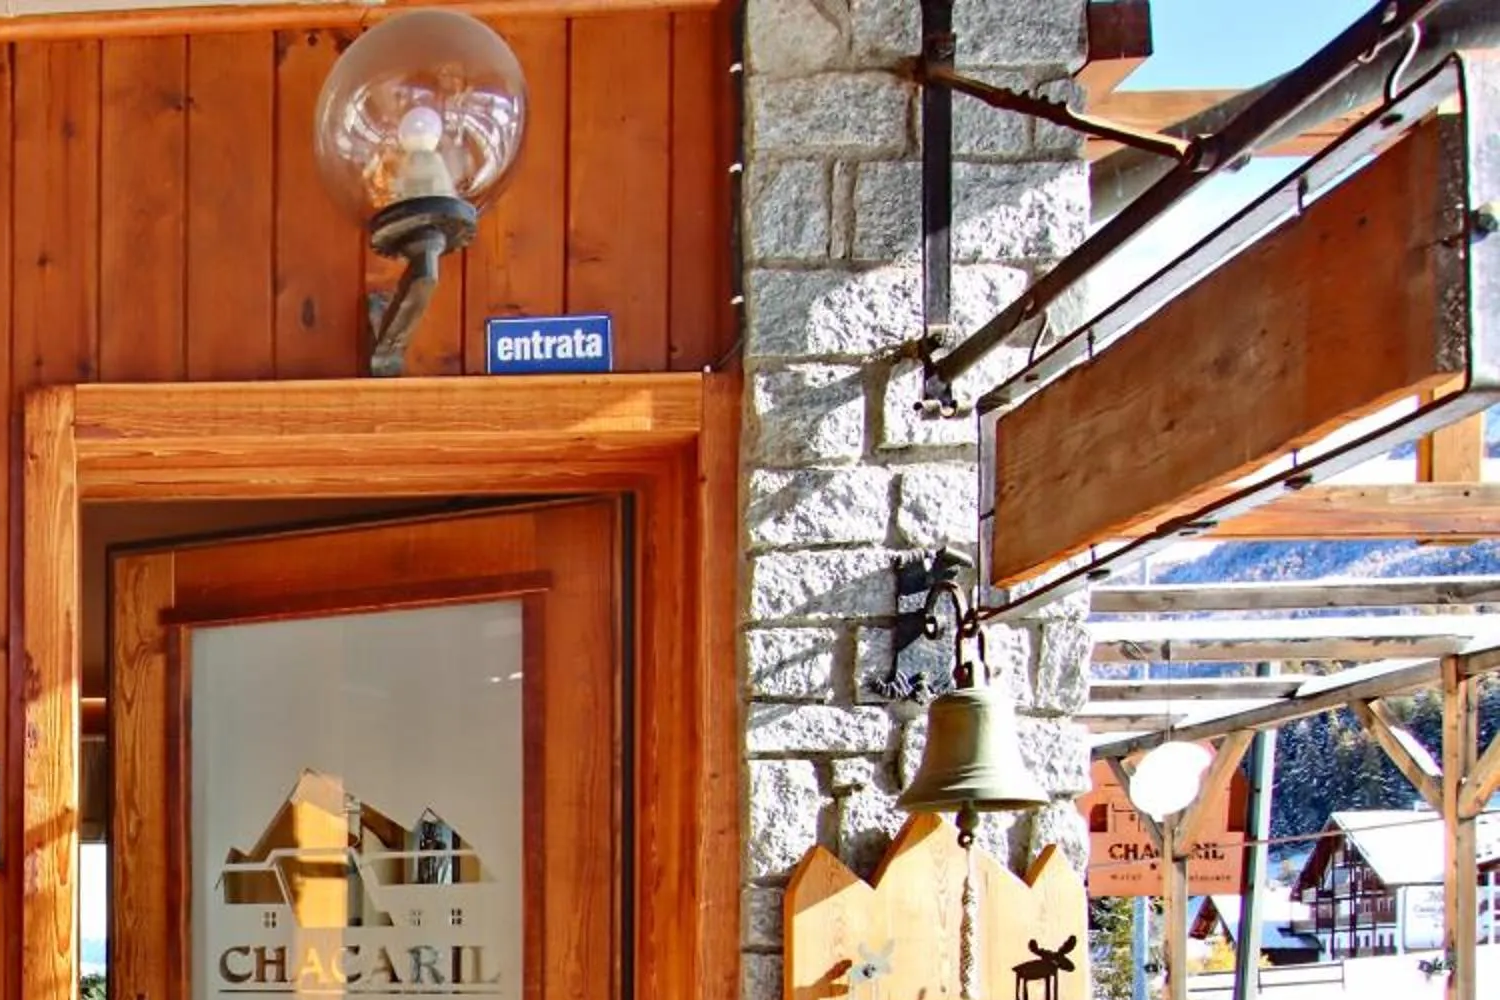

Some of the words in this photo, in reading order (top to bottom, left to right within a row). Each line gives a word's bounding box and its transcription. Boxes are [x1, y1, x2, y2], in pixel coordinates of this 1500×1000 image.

[497, 328, 603, 361] entrata
[1107, 843, 1225, 860] CHARIL
[218, 945, 501, 984] CHACARIL
